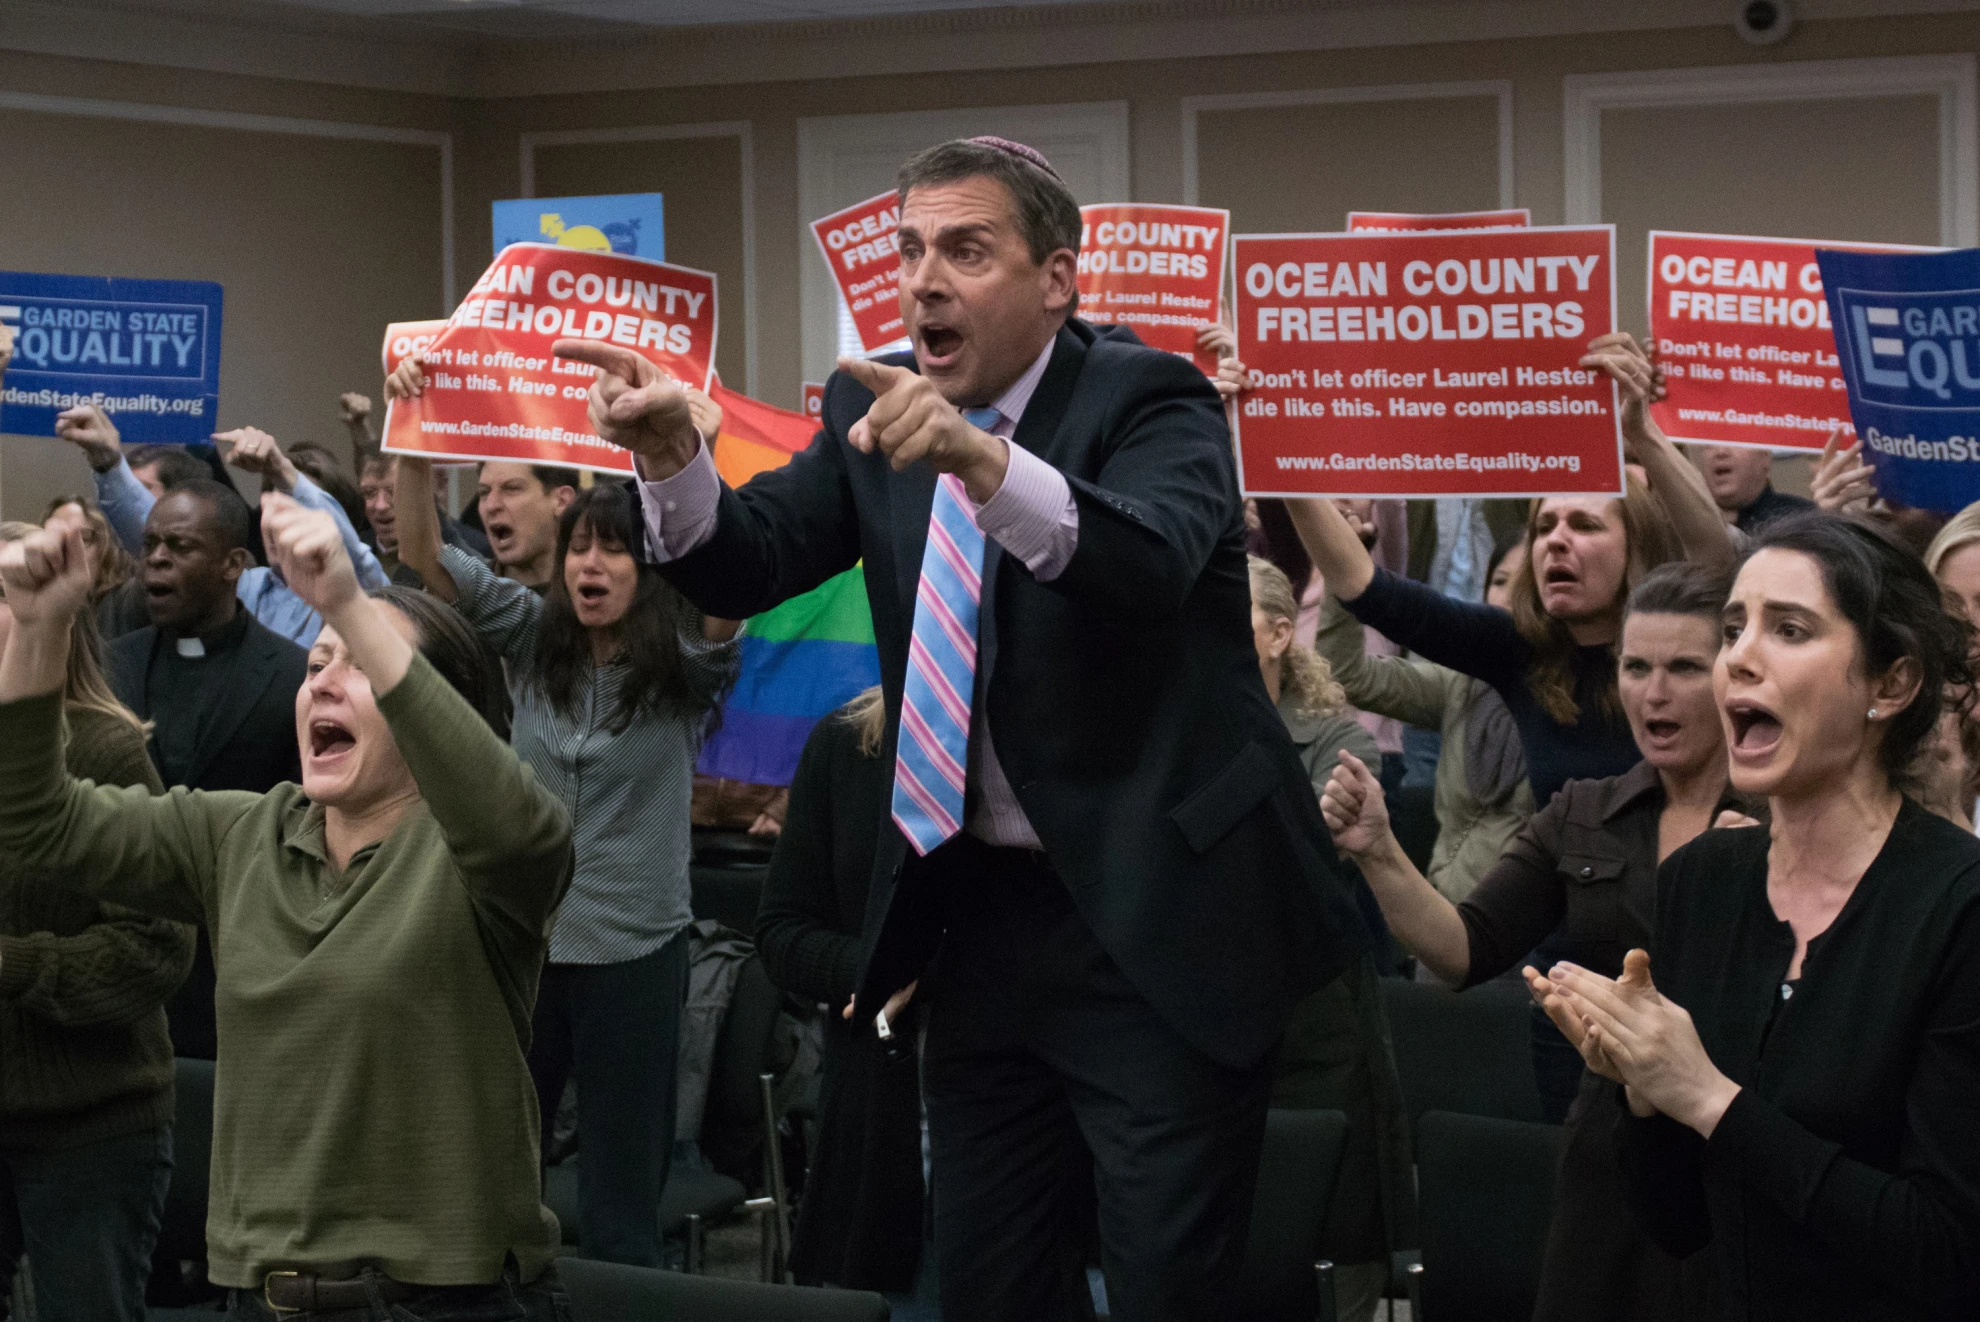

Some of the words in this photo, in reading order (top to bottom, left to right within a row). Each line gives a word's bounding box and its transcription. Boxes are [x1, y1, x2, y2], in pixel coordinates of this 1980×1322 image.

[1096, 221, 1219, 250] COUNTY
[1076, 250, 1208, 278] HOLDERS
[1245, 261, 1388, 298] OCEAN
[1403, 254, 1600, 297] COUNTY
[1660, 254, 1788, 290] OCEAN
[547, 269, 706, 320] COUNTY
[852, 296, 873, 311] die
[1105, 290, 1157, 306] Laurel
[1161, 292, 1212, 309] Hester
[23, 306, 121, 331] GARDEN
[128, 312, 197, 334] STATE
[1257, 301, 1585, 342] FREEHOLDERS
[1668, 290, 1833, 330] FREEHOL
[1904, 306, 1980, 337] GAR
[423, 347, 452, 366] on't
[456, 348, 479, 367] let
[483, 350, 547, 371] officer
[552, 356, 597, 377] Laur
[1659, 338, 1710, 357] Don't
[1715, 342, 1741, 359] let
[1747, 344, 1811, 365] officer
[1850, 305, 1980, 399] EQU
[435, 372, 462, 389] like
[466, 374, 502, 392] this.
[508, 376, 557, 396] Have
[1249, 368, 1307, 388] Don't
[1313, 369, 1343, 388] let
[1350, 369, 1426, 388] officer
[1433, 367, 1508, 388] Laurel
[1516, 366, 1597, 387] Hester
[1690, 363, 1725, 380] like
[1730, 365, 1772, 384] this.
[1778, 368, 1825, 388] Have
[1244, 397, 1277, 417] die
[1285, 397, 1324, 417] like
[1332, 397, 1381, 417] this.
[1389, 397, 1446, 417] Have
[1454, 395, 1607, 419] compassion.
[1866, 426, 1980, 463] GardenSt
[1275, 451, 1580, 473] www.GardenStateEquality.org
